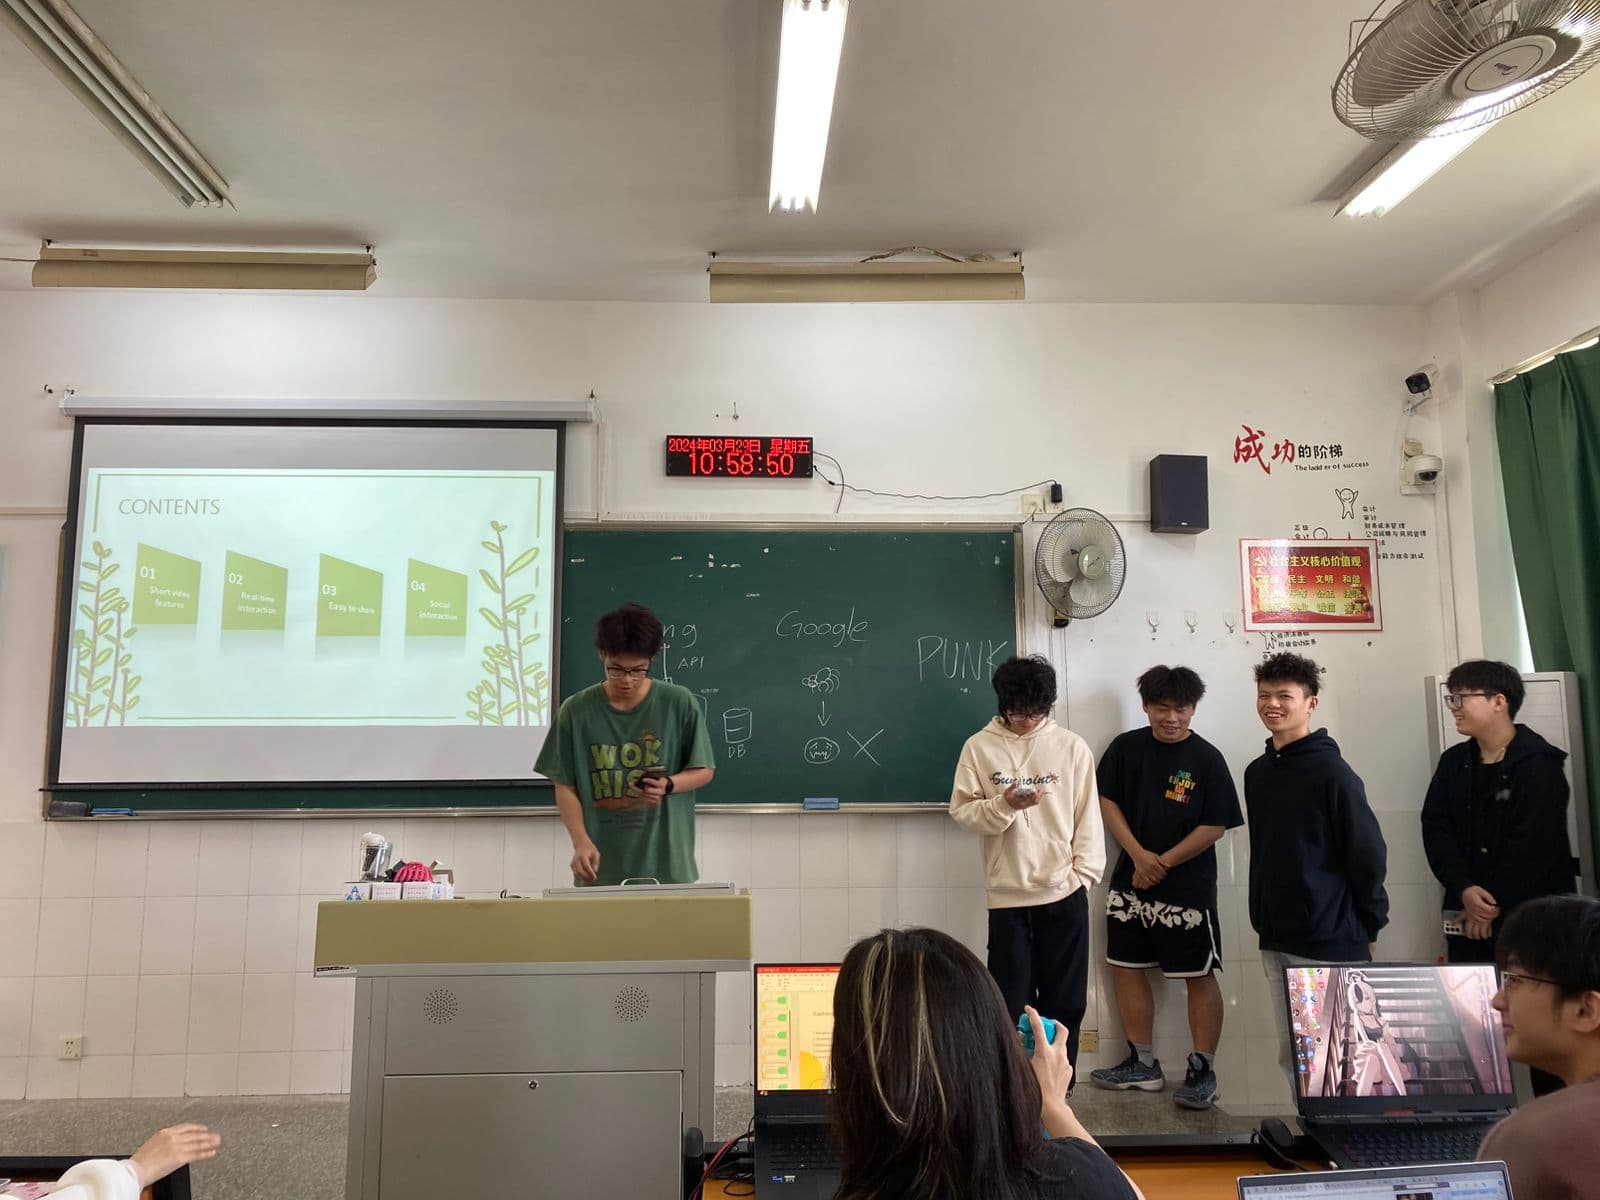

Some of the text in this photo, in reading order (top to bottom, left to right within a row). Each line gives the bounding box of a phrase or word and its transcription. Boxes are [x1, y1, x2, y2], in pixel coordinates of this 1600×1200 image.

[669, 438, 809, 454] 2024年03月29日 星期五
[689, 452, 794, 475] 10:58:50
[118, 498, 221, 515] CONTENTS
[140, 566, 156, 580] 01
[228, 573, 243, 585] 02
[1316, 574, 1334, 584] 文明
[150, 586, 191, 599] Short video
[322, 584, 337, 596] 03
[411, 580, 426, 592] 04
[155, 599, 185, 609] features
[329, 602, 347, 613] Easy
[357, 606, 375, 615] share
[429, 600, 451, 609] Social
[776, 608, 869, 647] Google
[677, 656, 704, 670] API
[917, 635, 1008, 681] PUNK
[591, 739, 662, 769] WOK
[728, 745, 746, 758] DB
[1168, 775, 1196, 790] ENJOY
